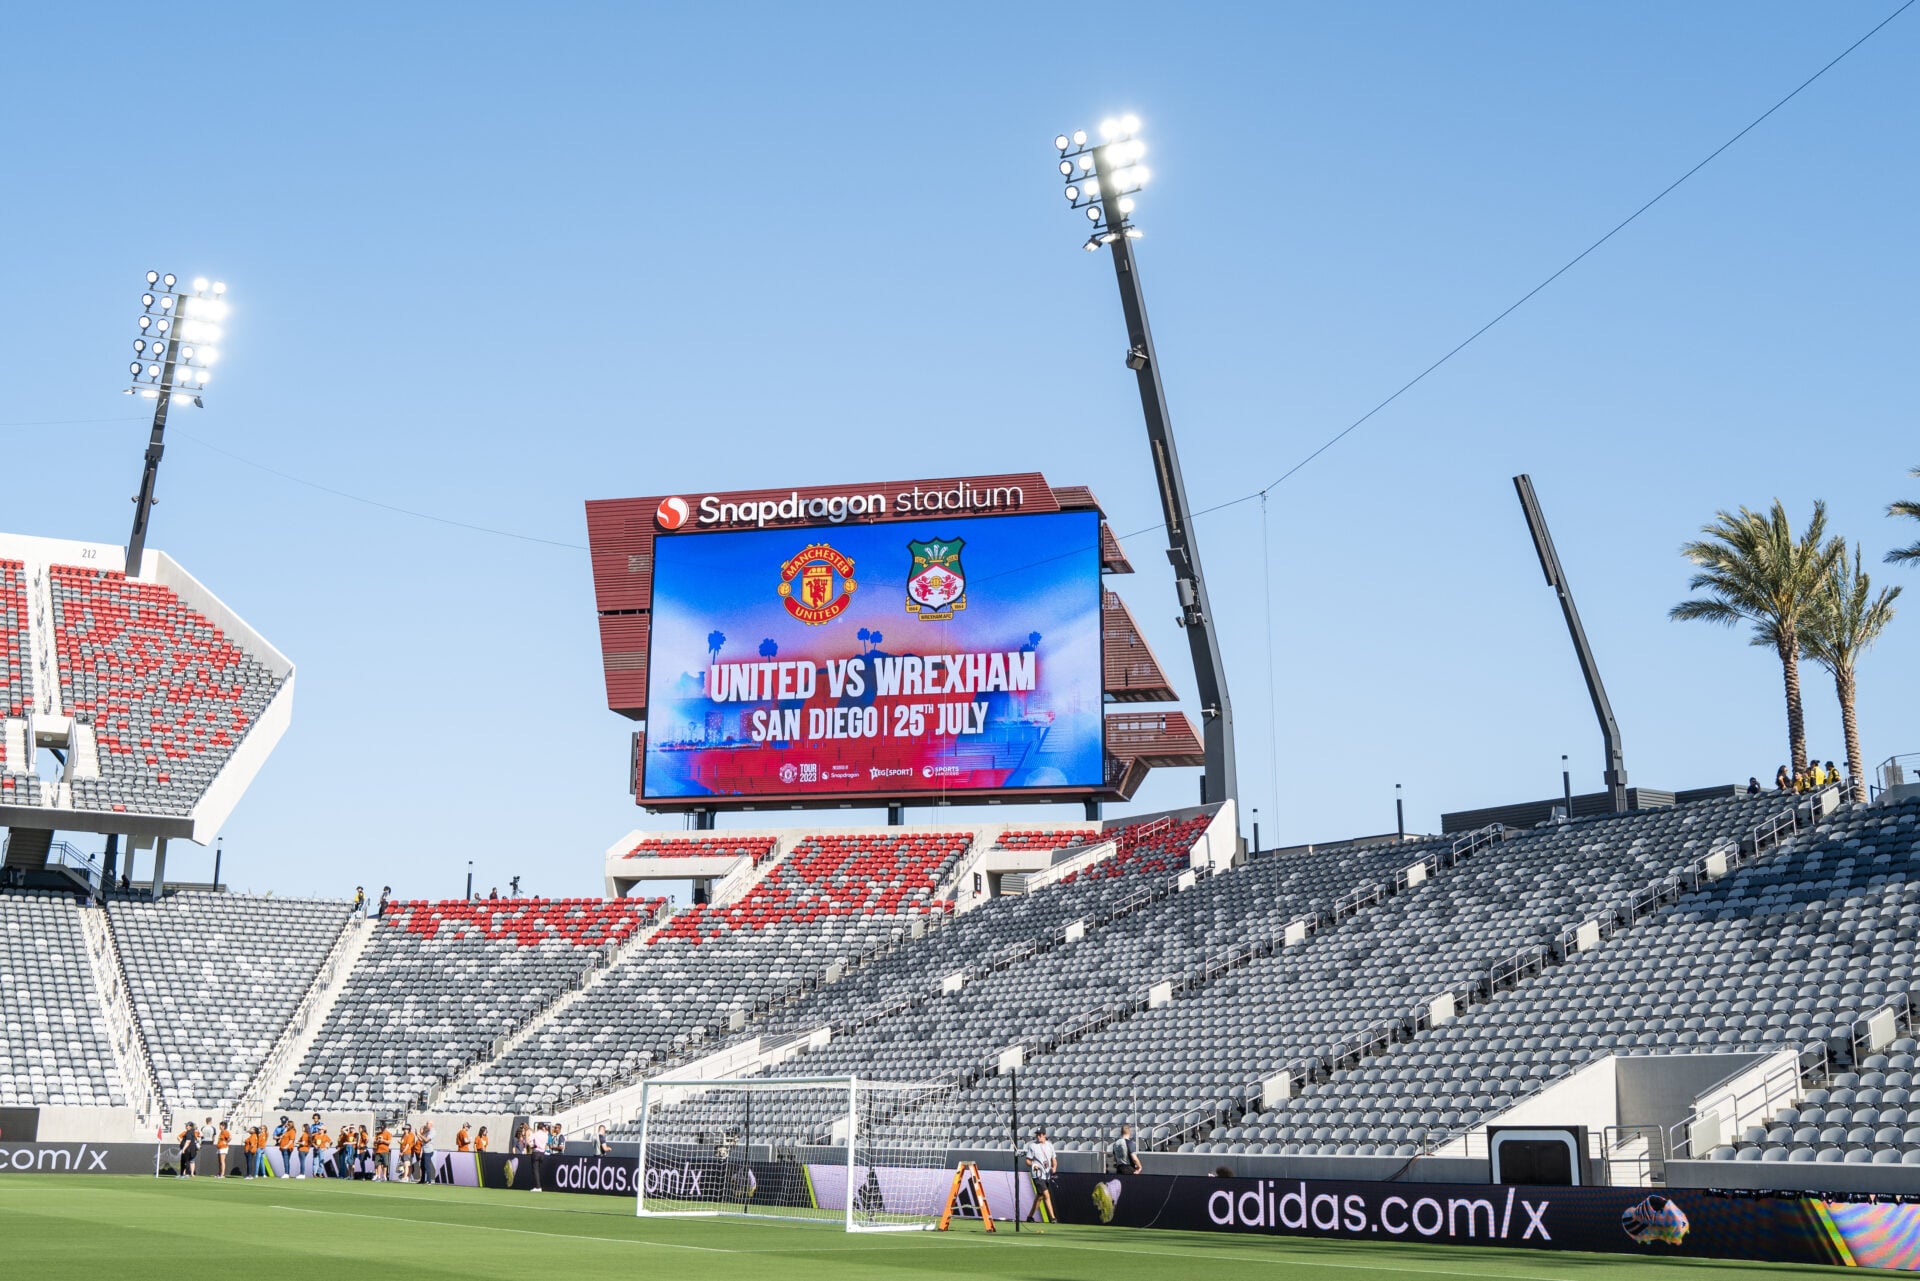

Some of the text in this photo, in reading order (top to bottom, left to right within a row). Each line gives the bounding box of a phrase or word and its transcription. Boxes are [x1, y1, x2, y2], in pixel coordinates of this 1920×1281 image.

[699, 482, 1024, 527] Snapdragon stadium
[82, 548, 97, 559] 212
[786, 549, 850, 577] MANCHESTER
[795, 605, 840, 620] UNITED
[710, 651, 1036, 703] UNITED VS WREXHAM
[751, 708, 801, 742] SAN
[808, 705, 878, 741] DIEGO
[935, 701, 989, 735] JULY
[799, 763, 817, 773] TOUR
[799, 773, 817, 783] 2023
[1208, 1180, 1552, 1240] adidas.com/x
